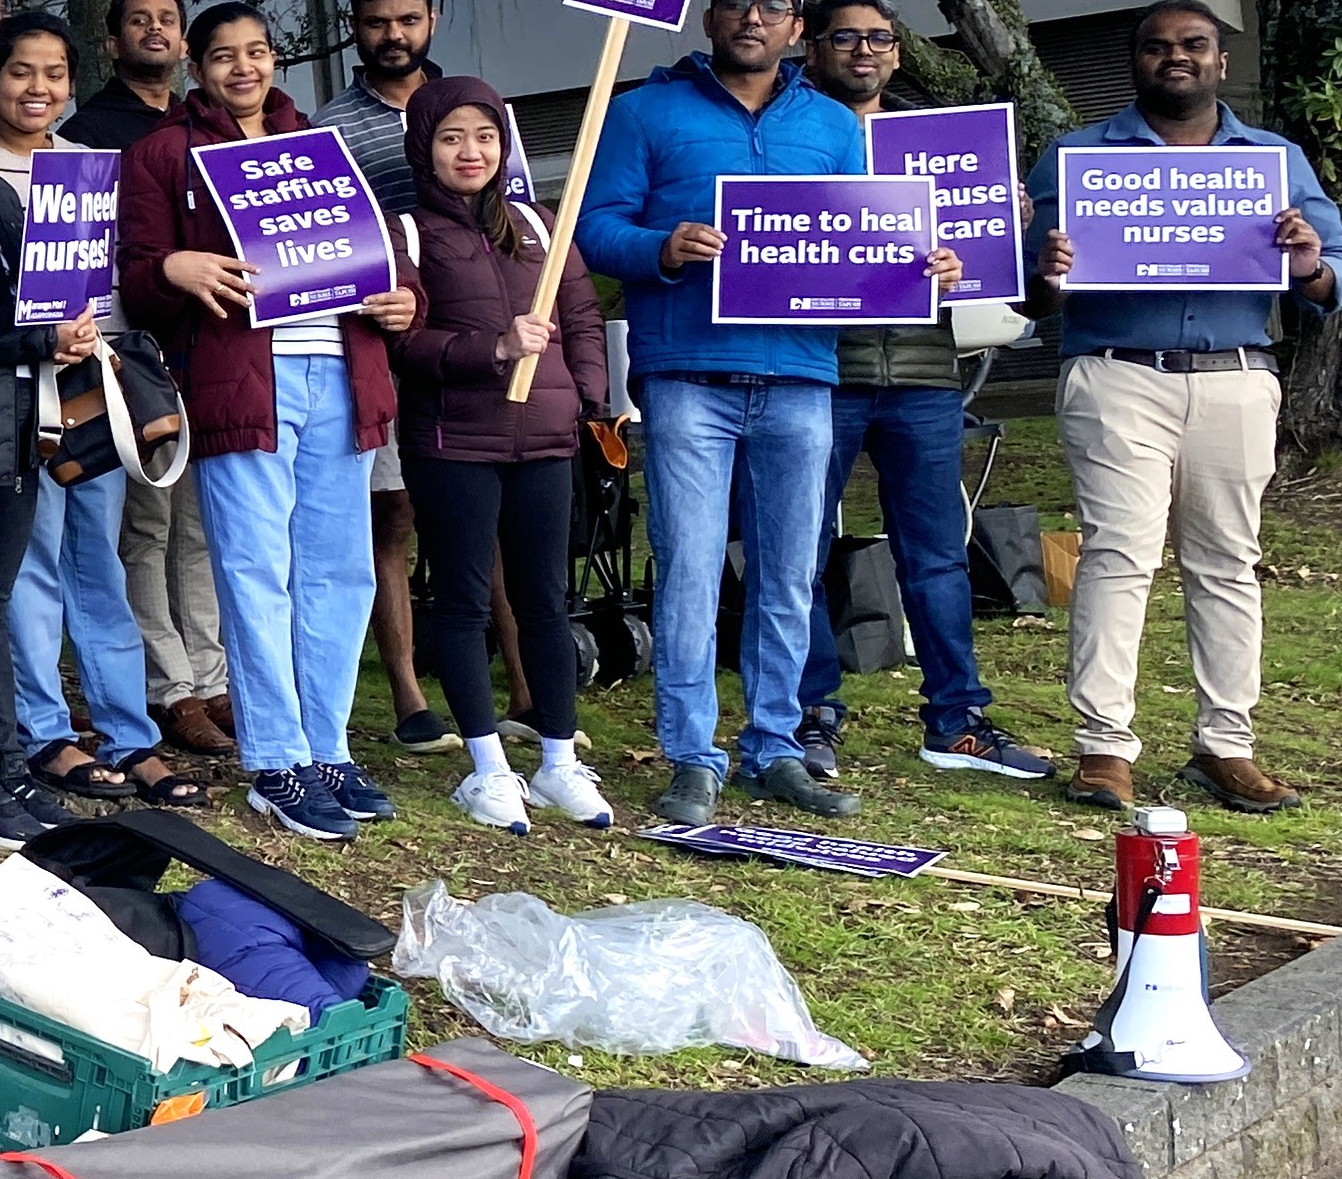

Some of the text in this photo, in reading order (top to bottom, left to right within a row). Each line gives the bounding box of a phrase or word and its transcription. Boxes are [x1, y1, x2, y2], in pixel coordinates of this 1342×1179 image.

[240, 153, 315, 180] Safe
[904, 152, 978, 175] Here
[1081, 167, 1265, 190] Good health
[31, 181, 118, 224] We need
[229, 175, 357, 210] staffing
[935, 184, 1008, 207] ause
[1075, 193, 1273, 217] needs valued
[259, 205, 351, 236] saves
[731, 207, 923, 232] Time to heal
[937, 217, 1006, 241] care
[1123, 224, 1225, 243] nurses
[24, 228, 110, 271] nurses!
[275, 238, 353, 268] lives
[740, 240, 915, 264] health cuts
